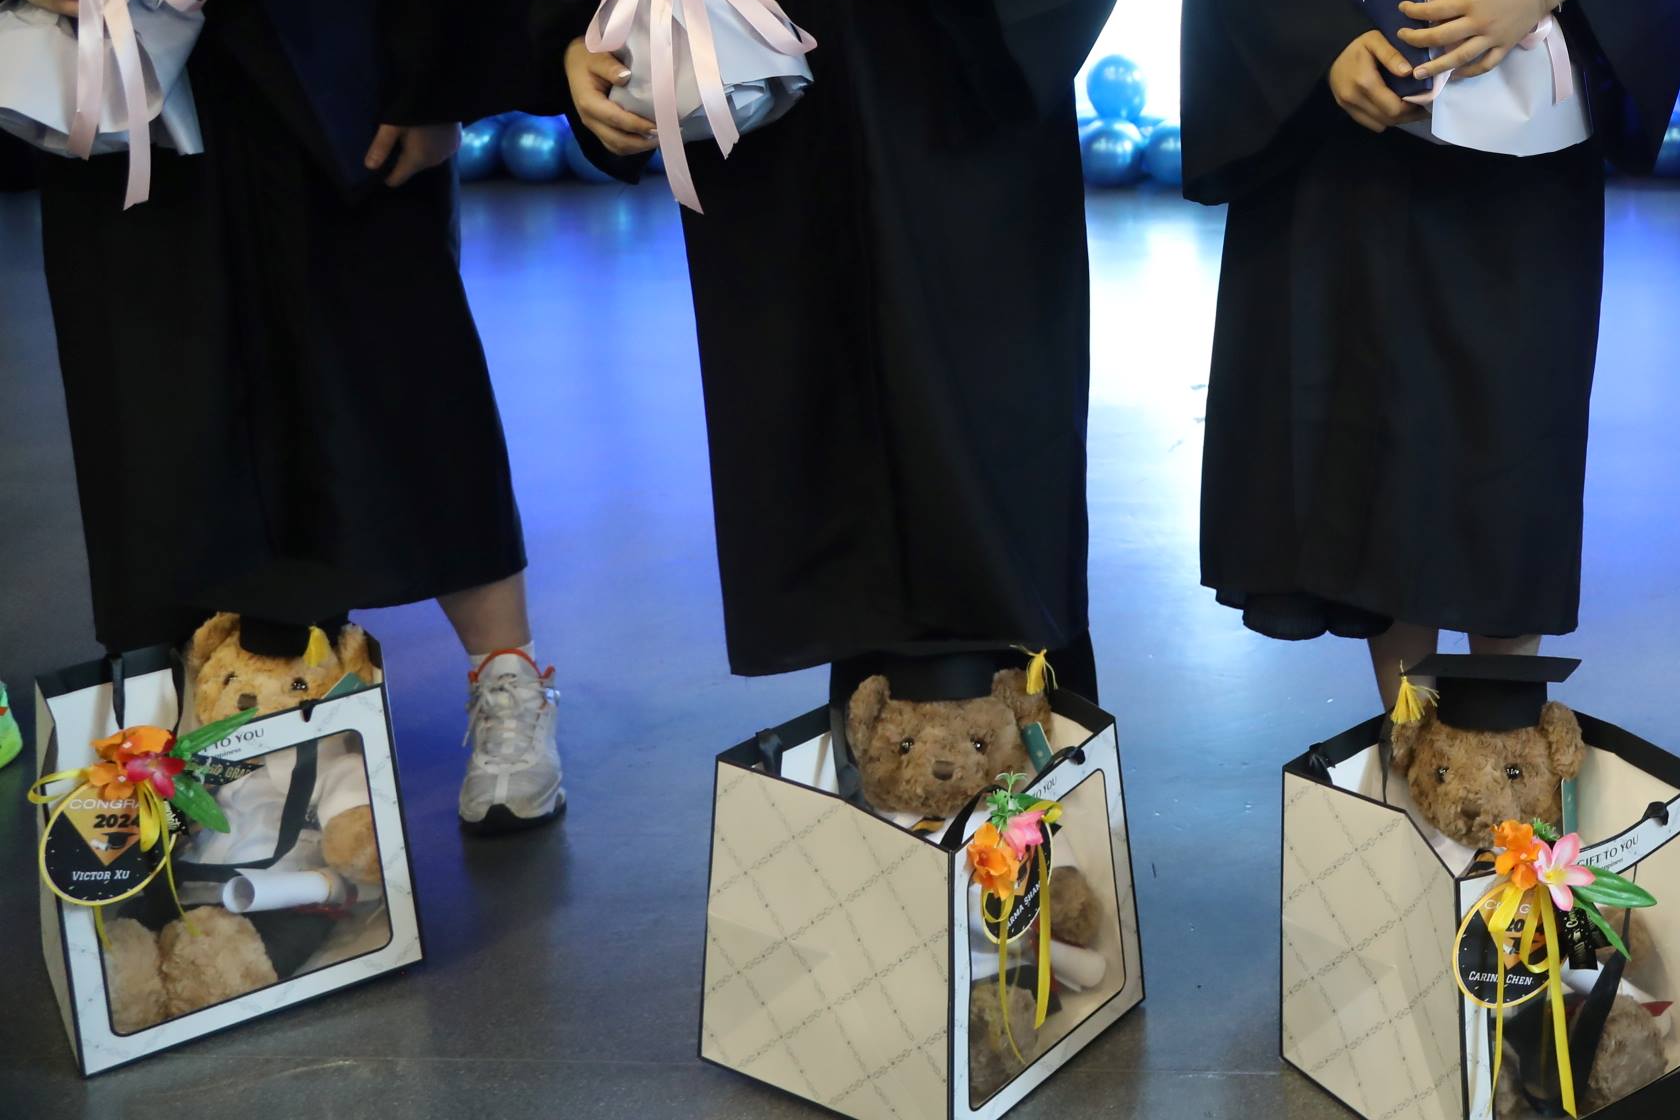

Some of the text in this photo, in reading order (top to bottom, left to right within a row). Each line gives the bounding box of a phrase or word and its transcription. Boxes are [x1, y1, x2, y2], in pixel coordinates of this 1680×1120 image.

[235, 727, 264, 744] YOU
[1603, 847, 1618, 860] TO
[1620, 834, 1639, 852] YOU
[72, 869, 130, 881] VICTOR XU
[1468, 970, 1533, 985] CARIN CHEN
